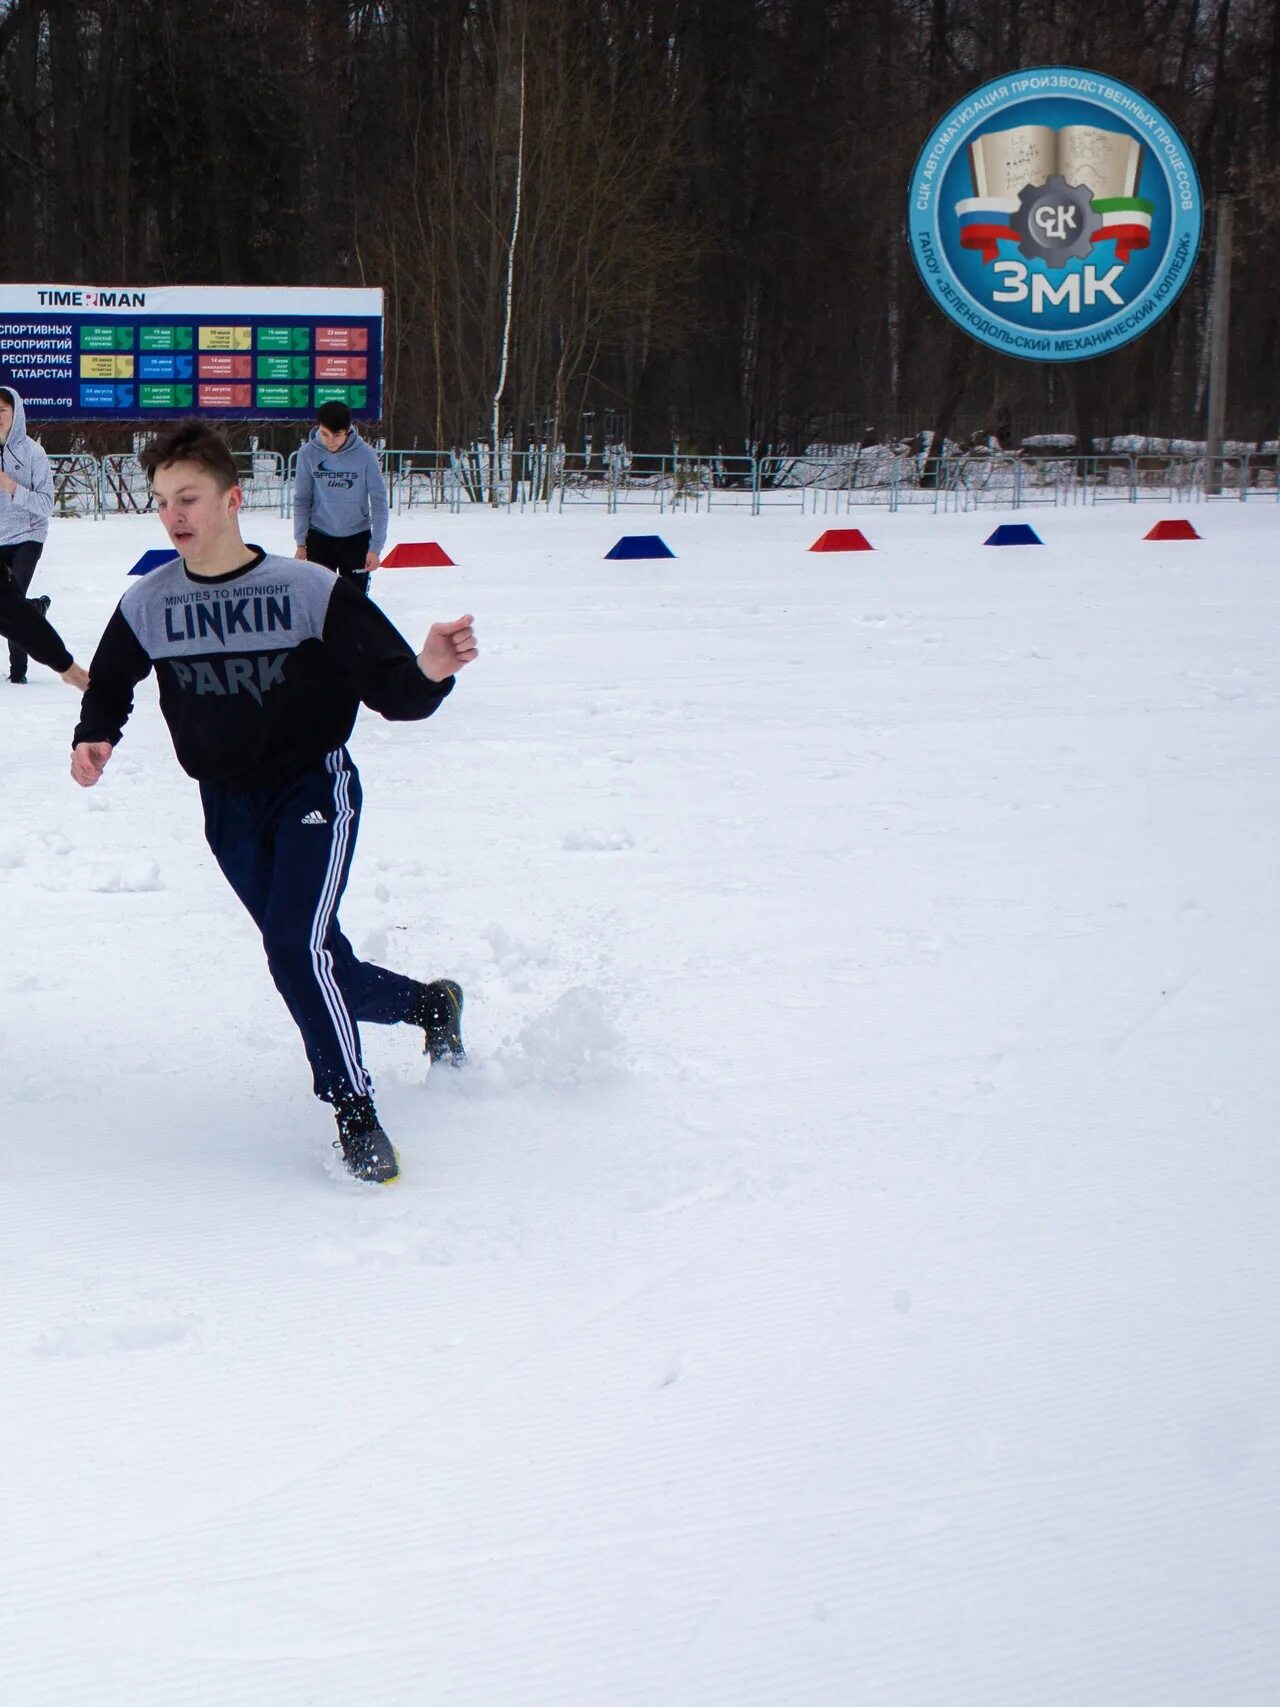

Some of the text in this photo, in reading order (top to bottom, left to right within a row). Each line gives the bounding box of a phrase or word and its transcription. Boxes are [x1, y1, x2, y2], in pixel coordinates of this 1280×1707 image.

[2, 354, 73, 365] РЕСПУБЛИКЕ
[10, 368, 73, 379] ТАТАРСТАН
[313, 471, 359, 480] SPORTS
[165, 584, 291, 606] MINUTES TO MIDNIGHT
[164, 595, 292, 647] LINKIN
[170, 652, 289, 708] PARK
